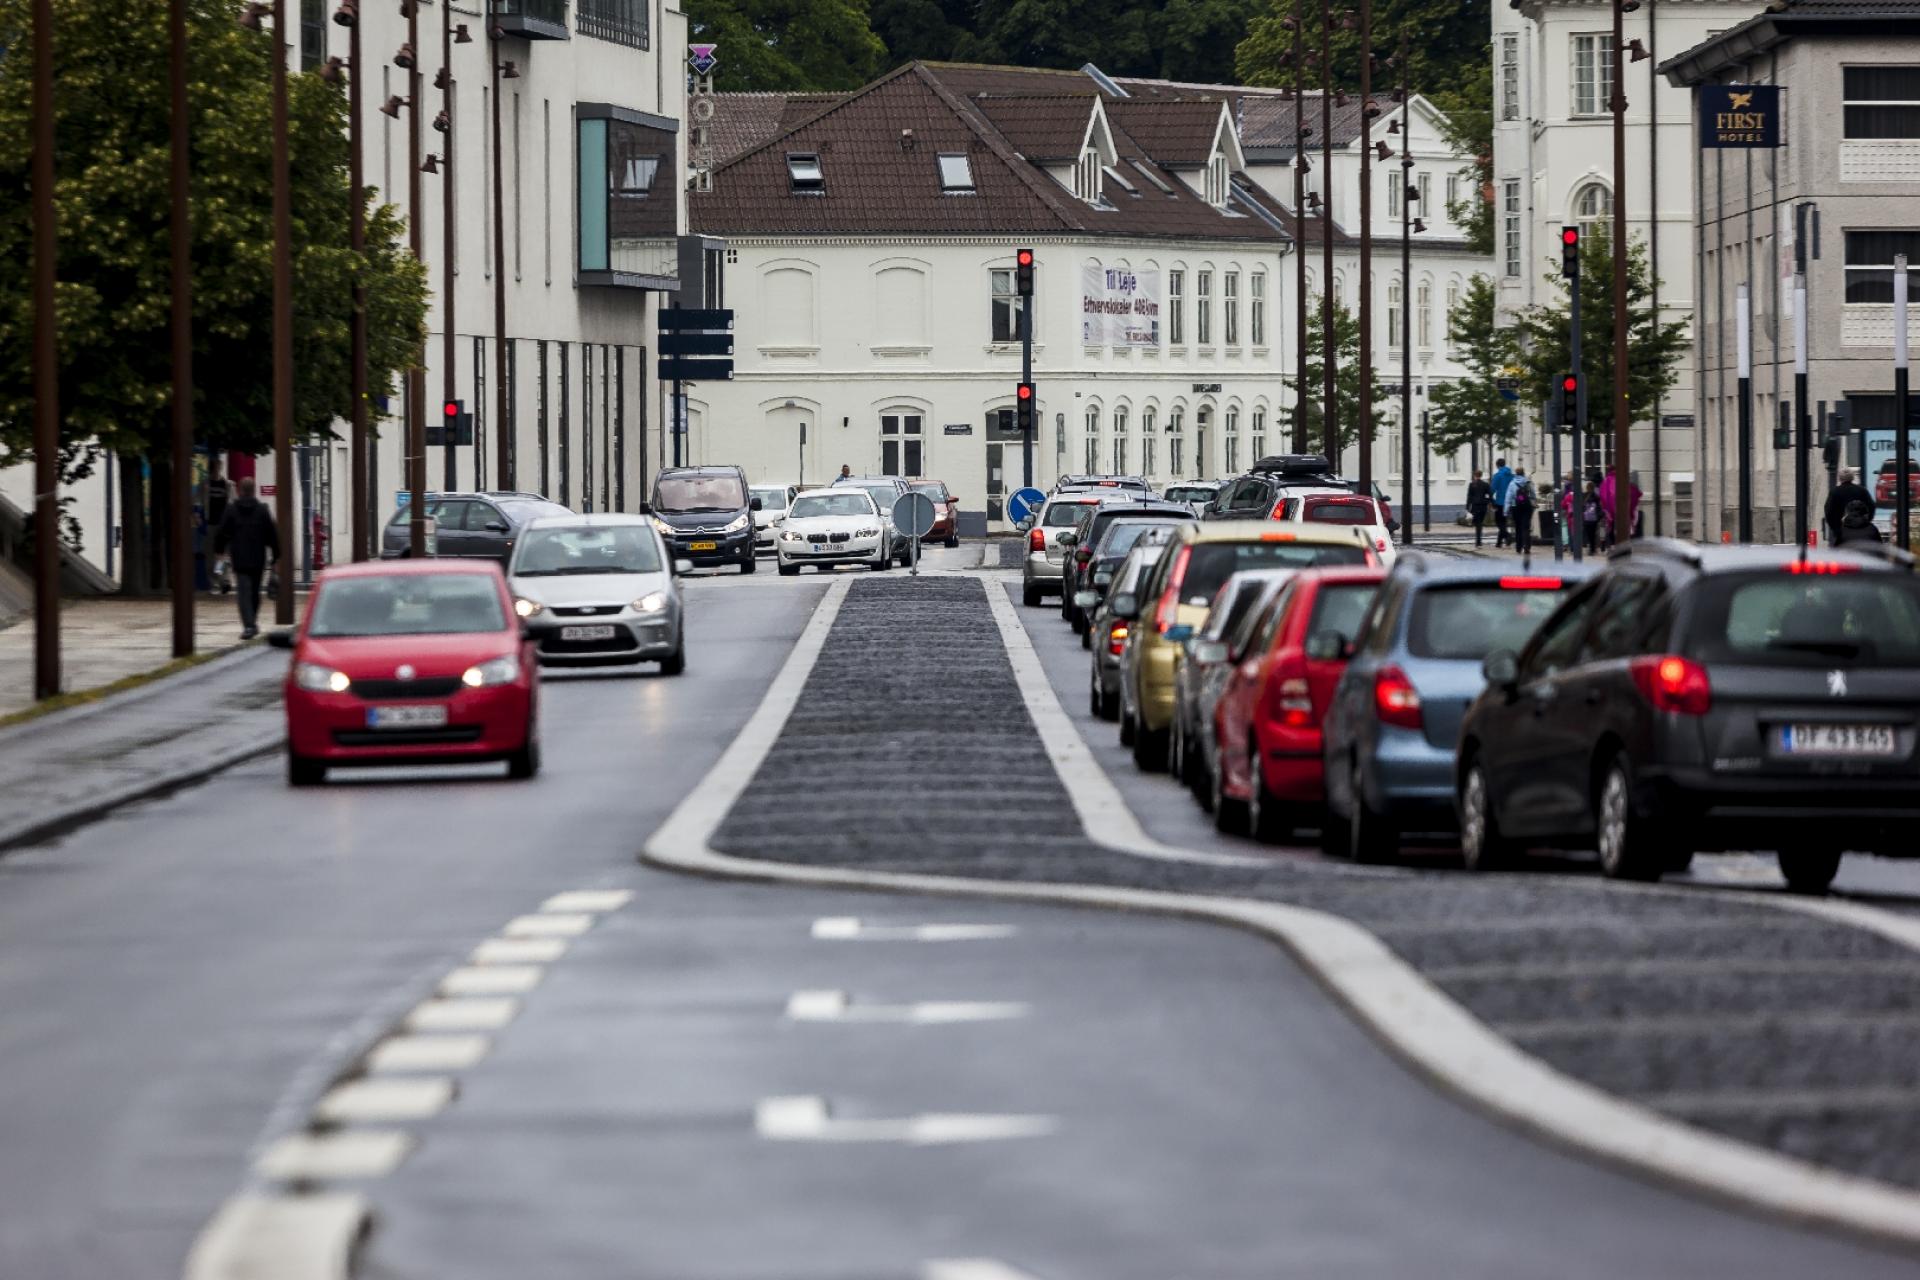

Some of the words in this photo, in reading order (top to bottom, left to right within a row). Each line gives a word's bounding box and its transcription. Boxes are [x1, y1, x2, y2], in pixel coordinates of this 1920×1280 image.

[1717, 112, 1765, 129] FIRST
[1718, 133, 1763, 142] HOTEL
[1106, 269, 1116, 290] Til
[1119, 271, 1137, 295] Leje
[1868, 439, 1917, 452] CITRN
